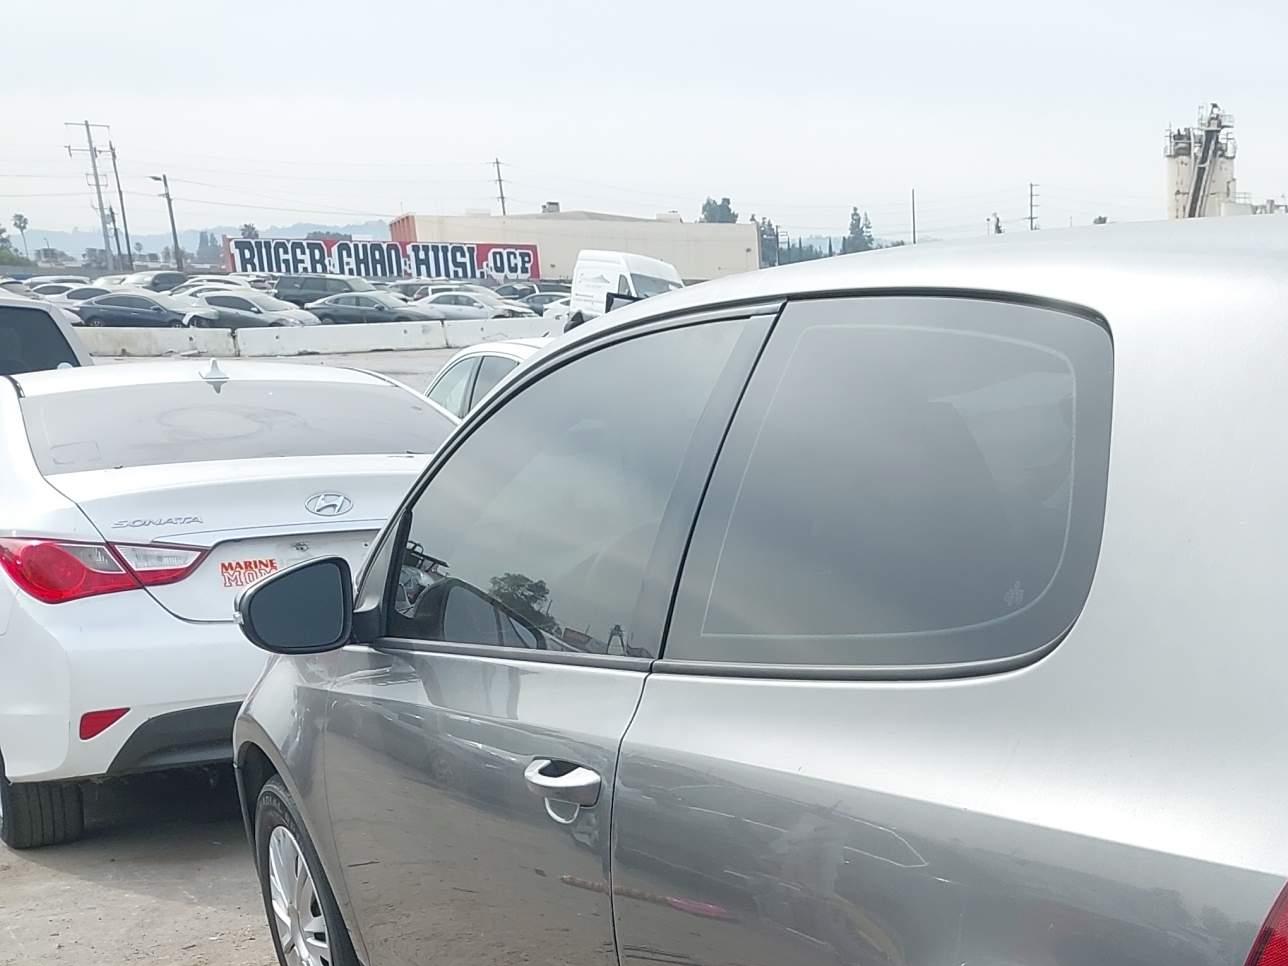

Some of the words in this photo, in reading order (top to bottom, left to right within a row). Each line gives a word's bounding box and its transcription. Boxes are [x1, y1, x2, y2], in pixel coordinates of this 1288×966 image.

[491, 250, 532, 275] OCP
[111, 516, 204, 529] SONATA
[221, 559, 278, 571] MARINE
